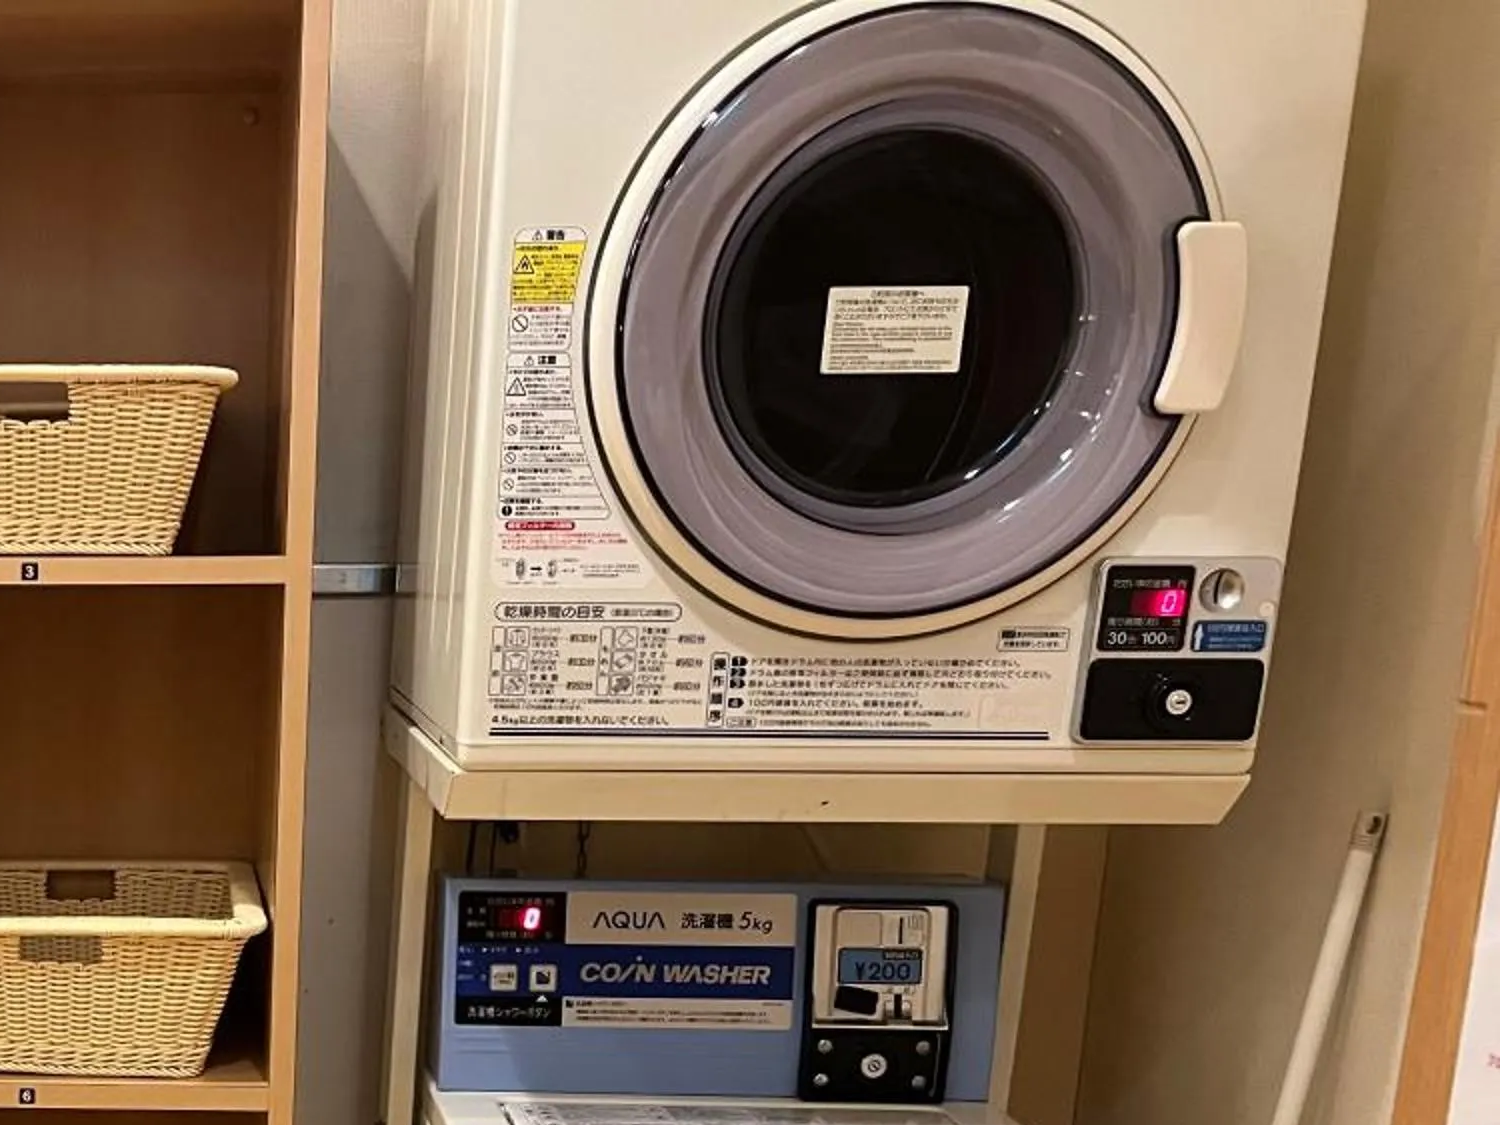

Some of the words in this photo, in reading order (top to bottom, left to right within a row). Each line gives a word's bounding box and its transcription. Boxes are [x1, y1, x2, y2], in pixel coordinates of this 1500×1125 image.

[1161, 589, 1178, 613] 0
[523, 907, 542, 930] 0
[592, 911, 666, 930] AQUA
[681, 913, 733, 930] 洗濯機
[739, 911, 774, 935] 5kg
[580, 955, 656, 983] COIN
[663, 963, 772, 985] WASHER
